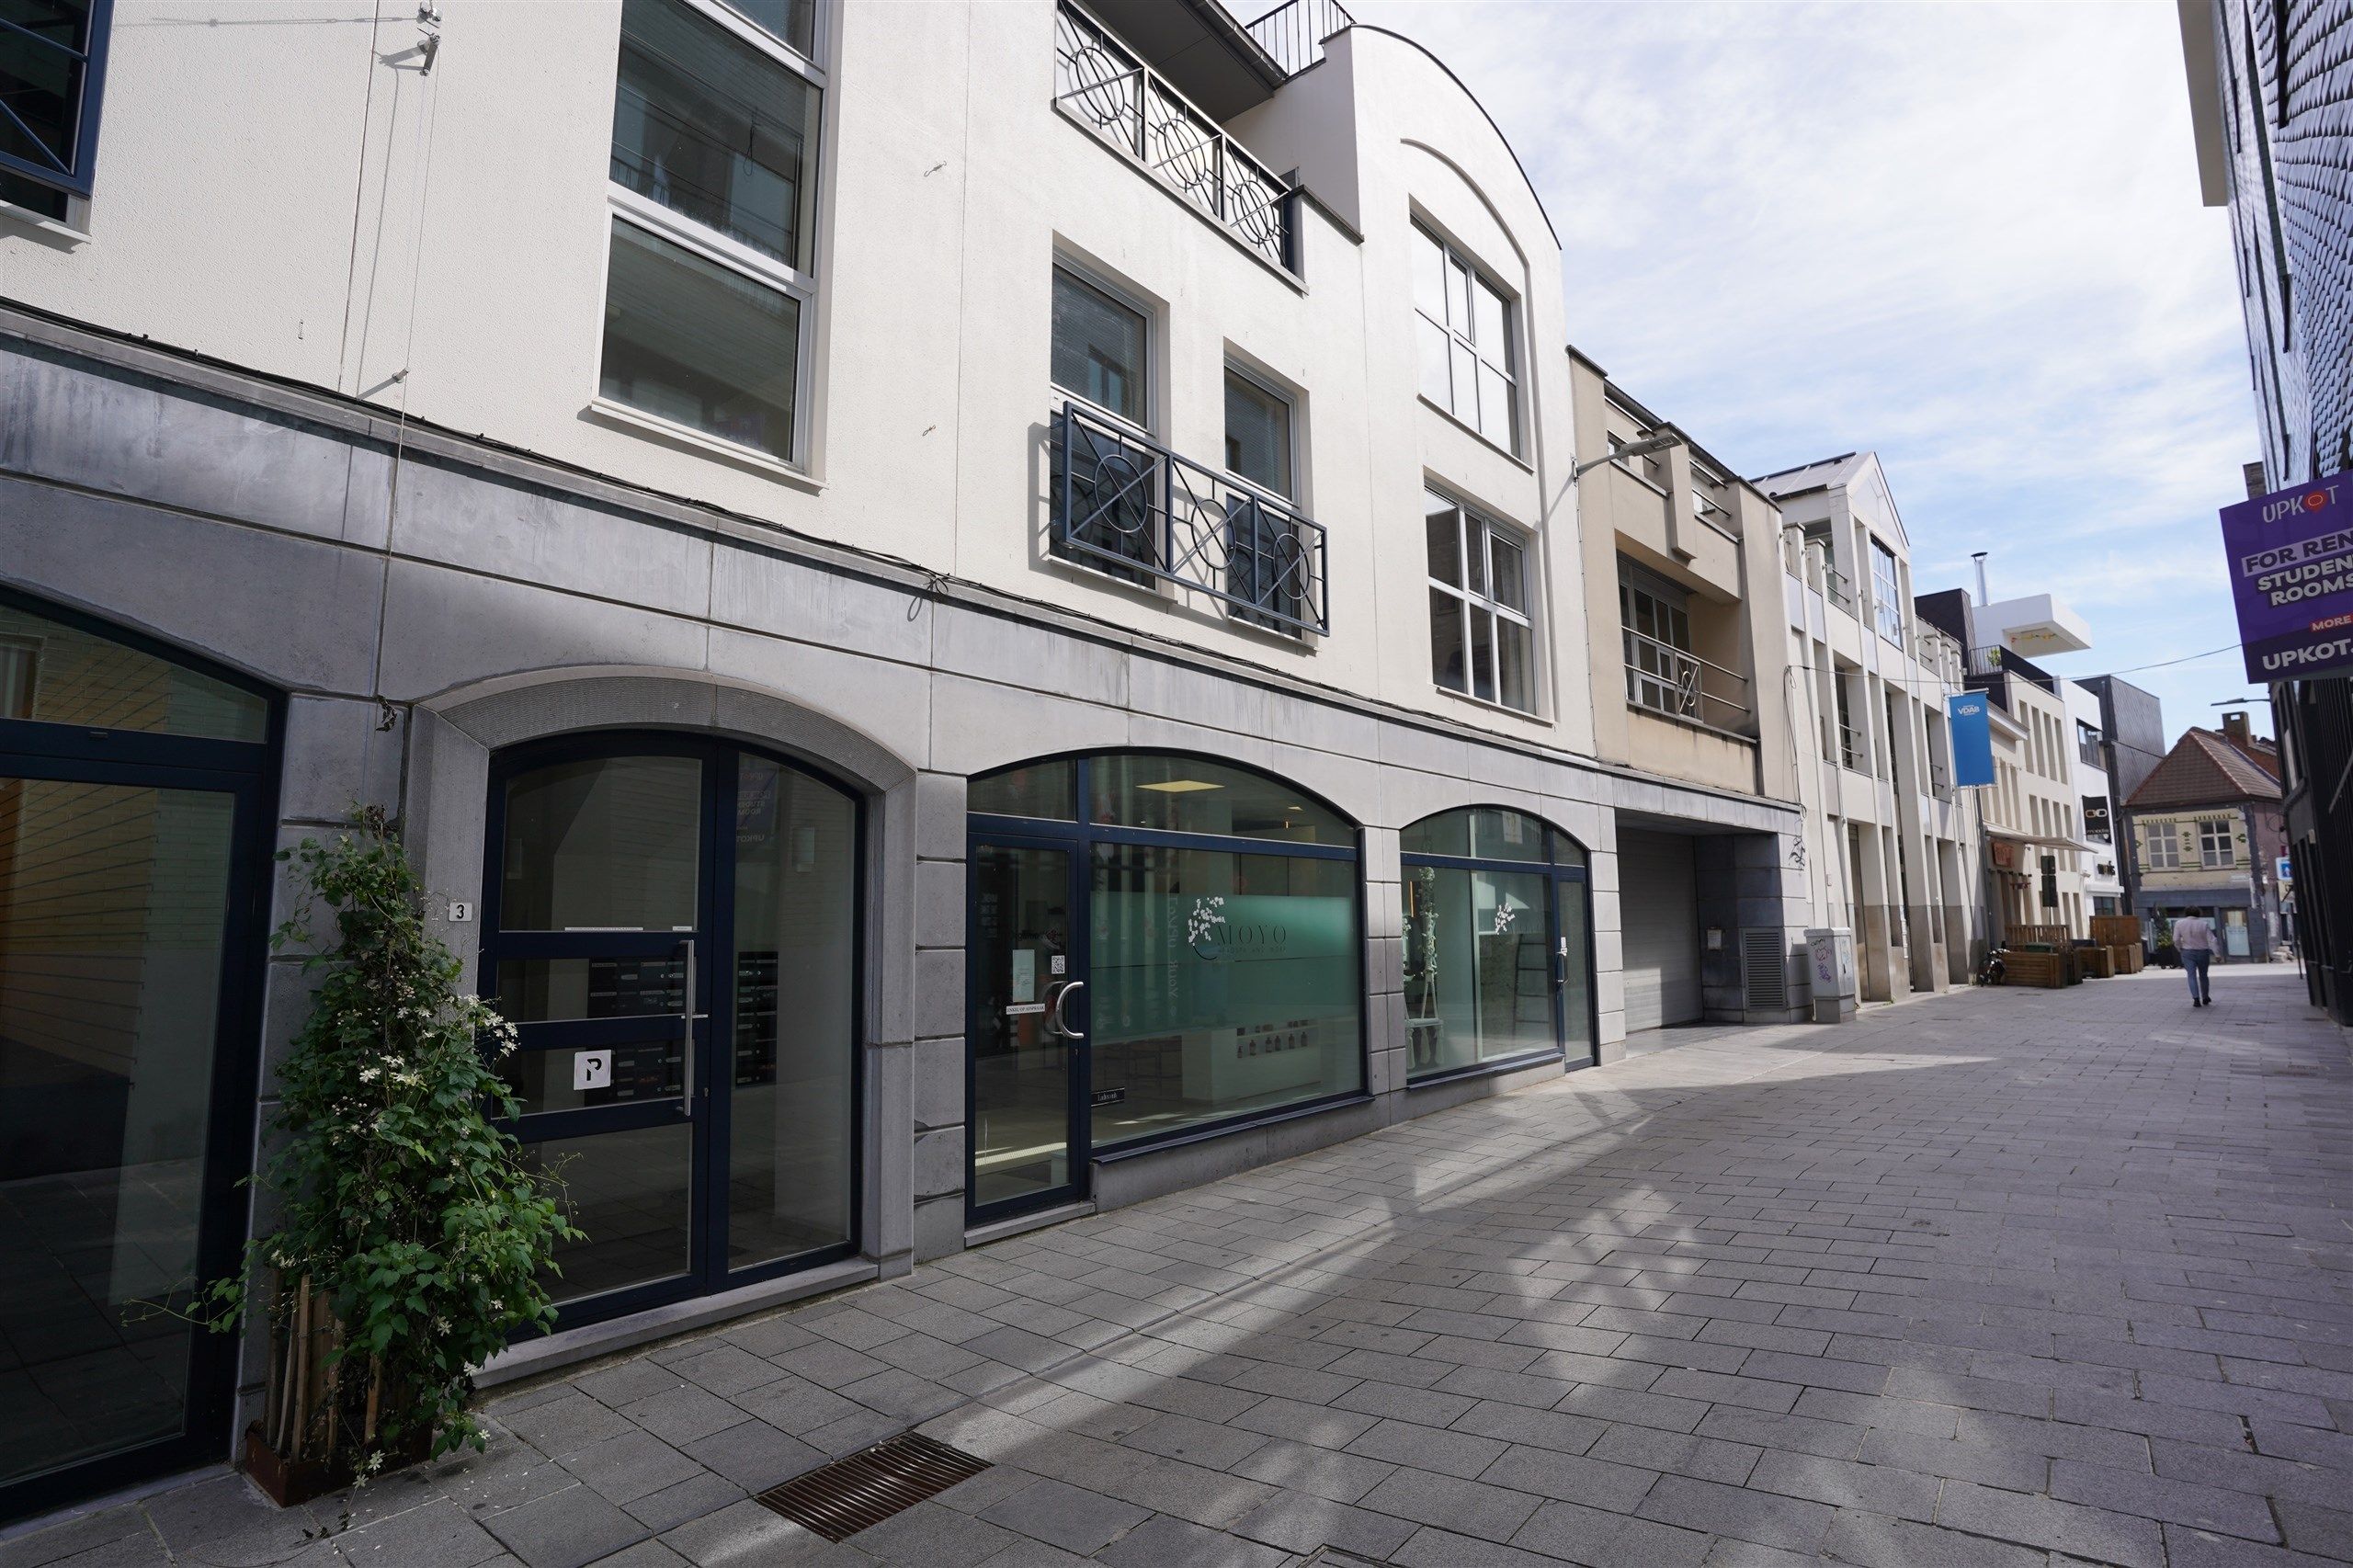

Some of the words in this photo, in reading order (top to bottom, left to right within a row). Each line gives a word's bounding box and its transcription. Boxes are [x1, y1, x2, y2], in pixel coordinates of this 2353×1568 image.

[2262, 484, 2339, 523] UPKOT
[2245, 548, 2298, 574] FOR
[2302, 530, 2353, 558] REN
[2257, 553, 2353, 591] STUDEN
[2312, 615, 2352, 631] MORE
[1957, 705, 1980, 715] VDAB
[456, 903, 465, 919] 3
[1217, 925, 1287, 945] MOYO
